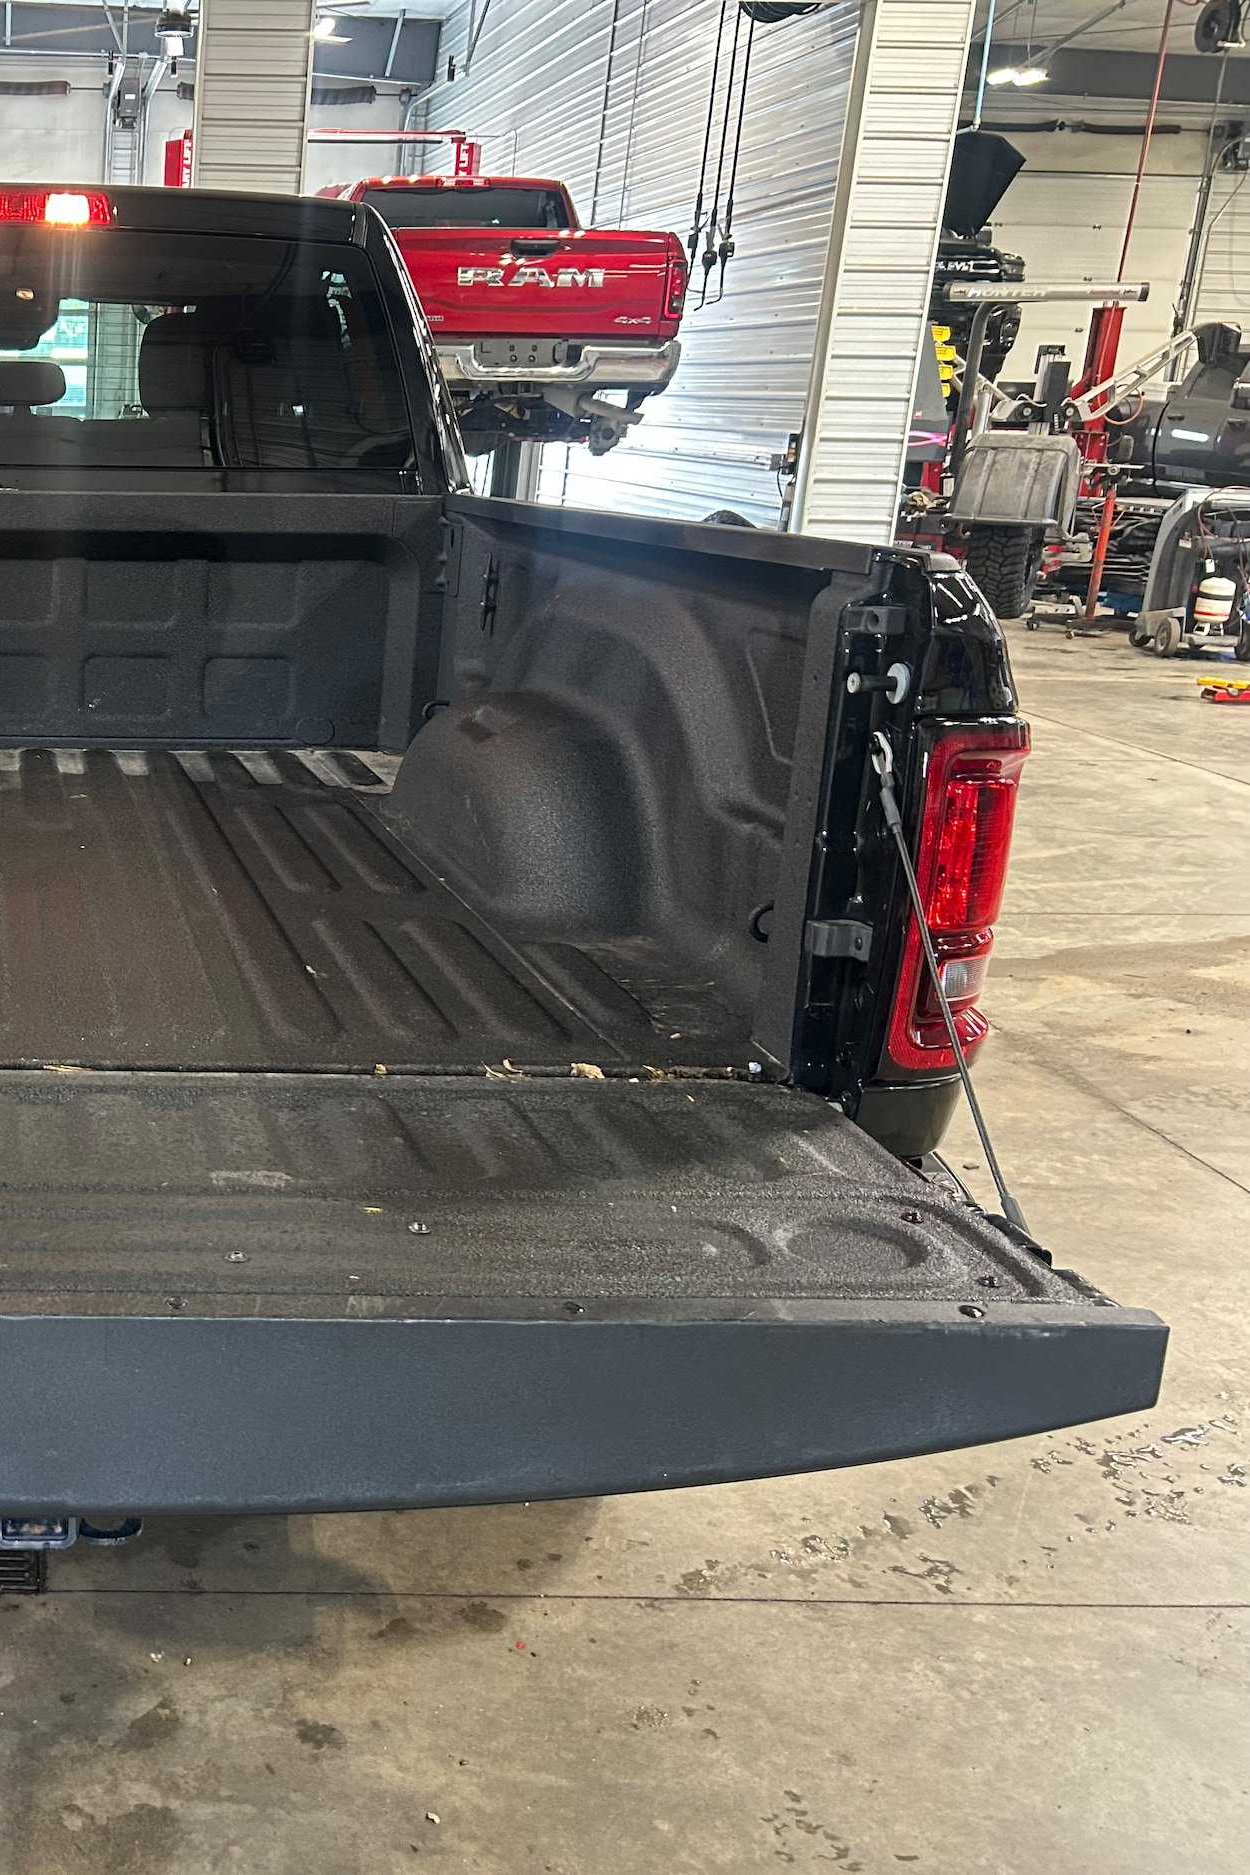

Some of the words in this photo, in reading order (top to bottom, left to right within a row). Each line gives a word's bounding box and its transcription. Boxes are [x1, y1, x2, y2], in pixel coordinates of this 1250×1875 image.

[459, 143, 470, 168] LIFT
[457, 267, 606, 287] RAM
[967, 286, 1046, 298] HUNTER
[613, 316, 651, 324] 4x4
